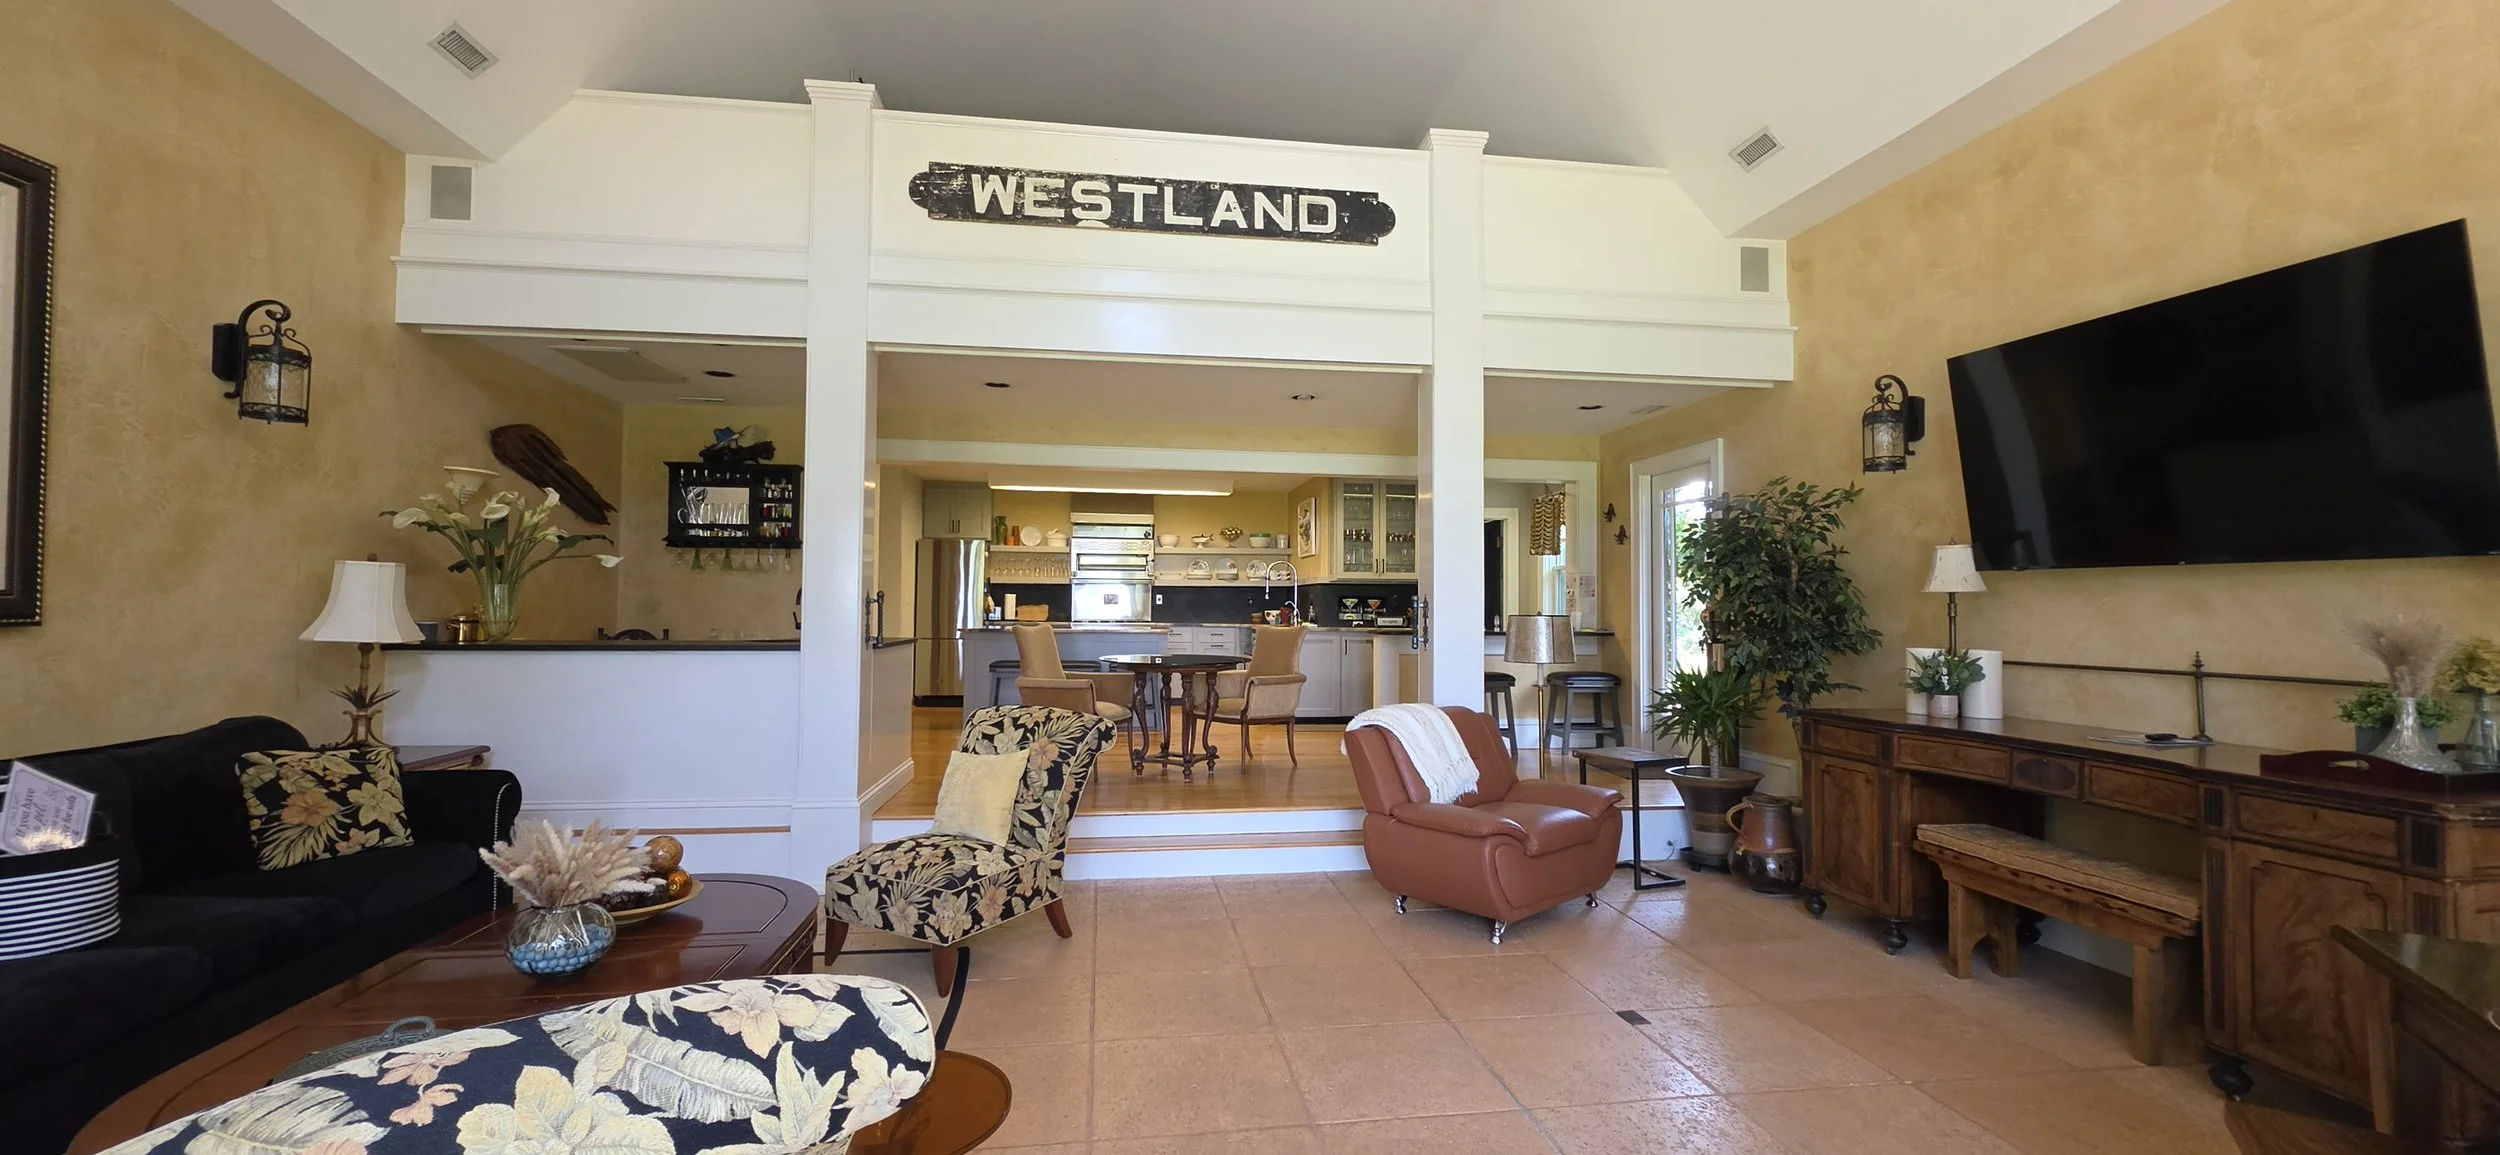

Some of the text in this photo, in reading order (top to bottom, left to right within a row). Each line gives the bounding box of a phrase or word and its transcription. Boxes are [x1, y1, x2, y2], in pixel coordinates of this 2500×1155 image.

[971, 173, 1338, 234] WESTLAND
[21, 788, 35, 810] have
[19, 811, 31, 829] you
